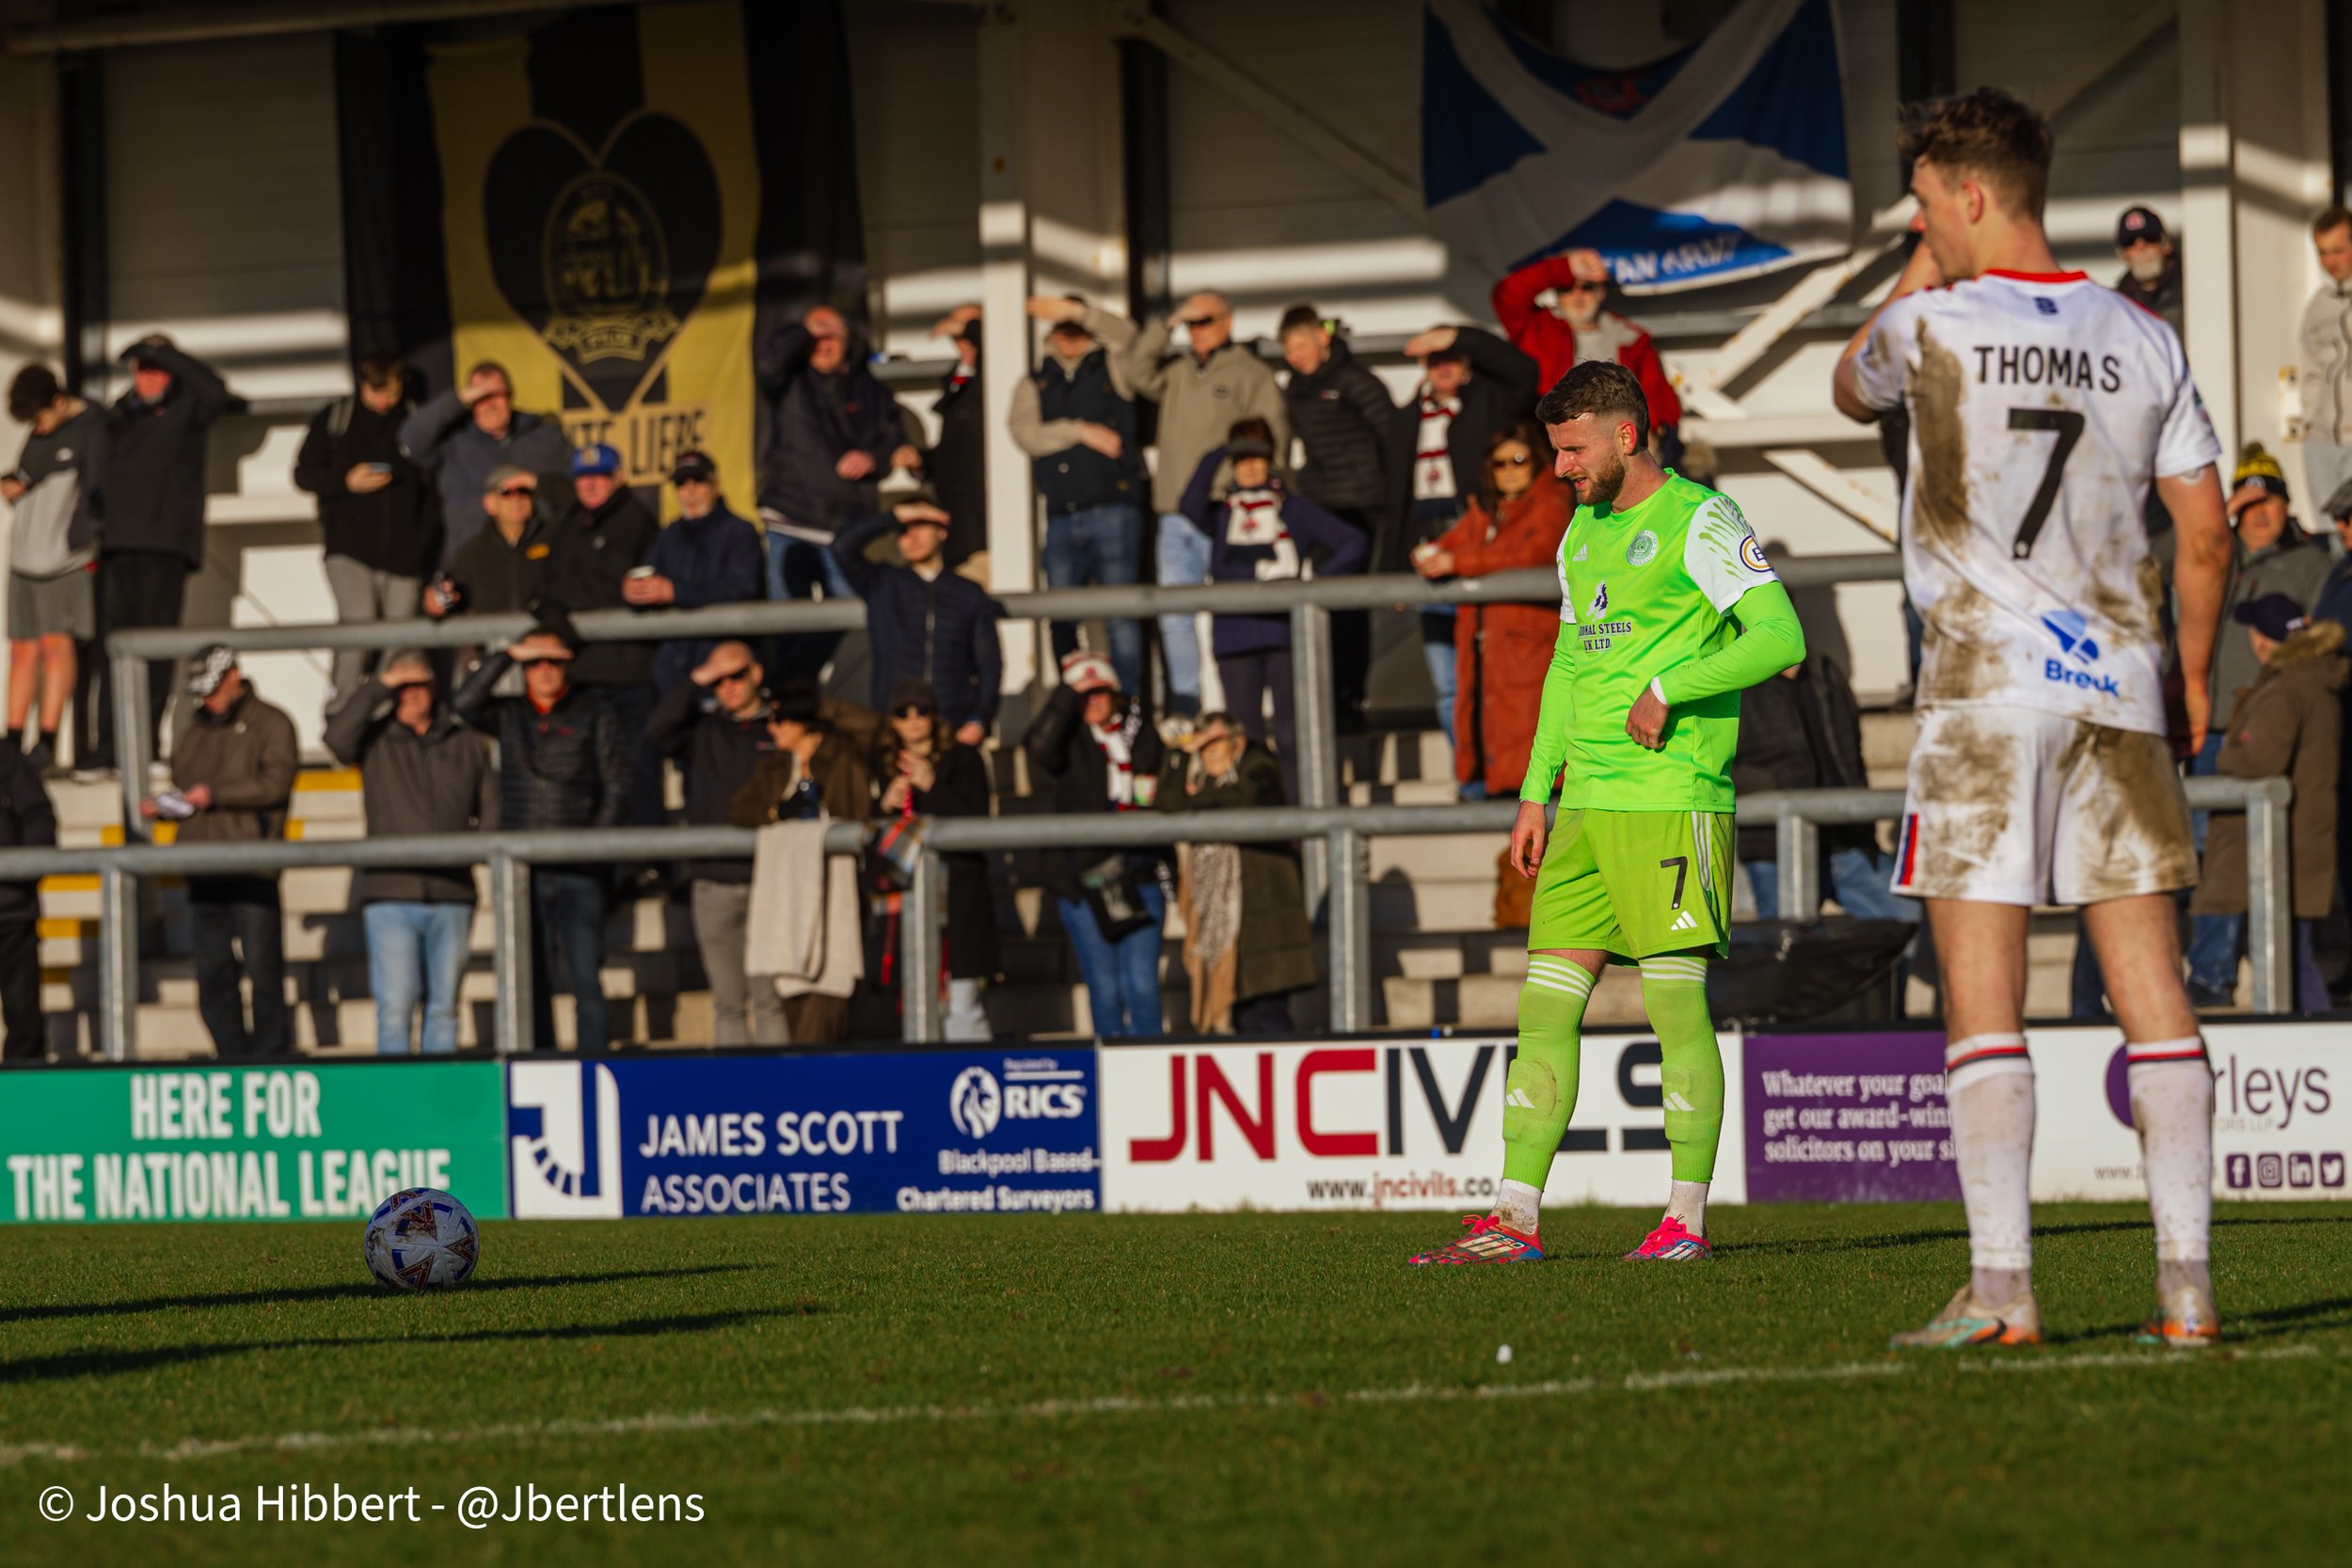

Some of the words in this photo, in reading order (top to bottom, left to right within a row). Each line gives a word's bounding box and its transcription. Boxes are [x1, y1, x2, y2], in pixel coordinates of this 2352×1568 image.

[1974, 345, 2122, 394] THOMAS
[2007, 407, 2086, 560] 7
[1598, 622, 1632, 635] STEELS
[1660, 856, 1688, 910] 7
[130, 1073, 232, 1140] HERE
[243, 1071, 322, 1137] FOR
[1004, 1085, 1084, 1118] RICS
[1130, 1041, 1671, 1163] JNCIVS
[1762, 1069, 1856, 1097] Whatever
[1858, 1074, 1906, 1102] your
[640, 1113, 766, 1158] JAMES
[776, 1111, 903, 1155] SCOTT
[1763, 1106, 1796, 1136] get
[1799, 1108, 1835, 1130] our
[938, 1148, 1031, 1178] Blackpool
[1764, 1134, 1855, 1163] solicitors
[1857, 1140, 1885, 1161] on
[1887, 1140, 1935, 1167] your
[8, 1154, 86, 1221] THE
[98, 1152, 290, 1219] NATIONAL
[299, 1148, 451, 1218] LEAGUE
[642, 1173, 850, 1213] ASSOCIATES
[897, 1185, 994, 1212] Chartered
[996, 1185, 1094, 1214] Surveyors
